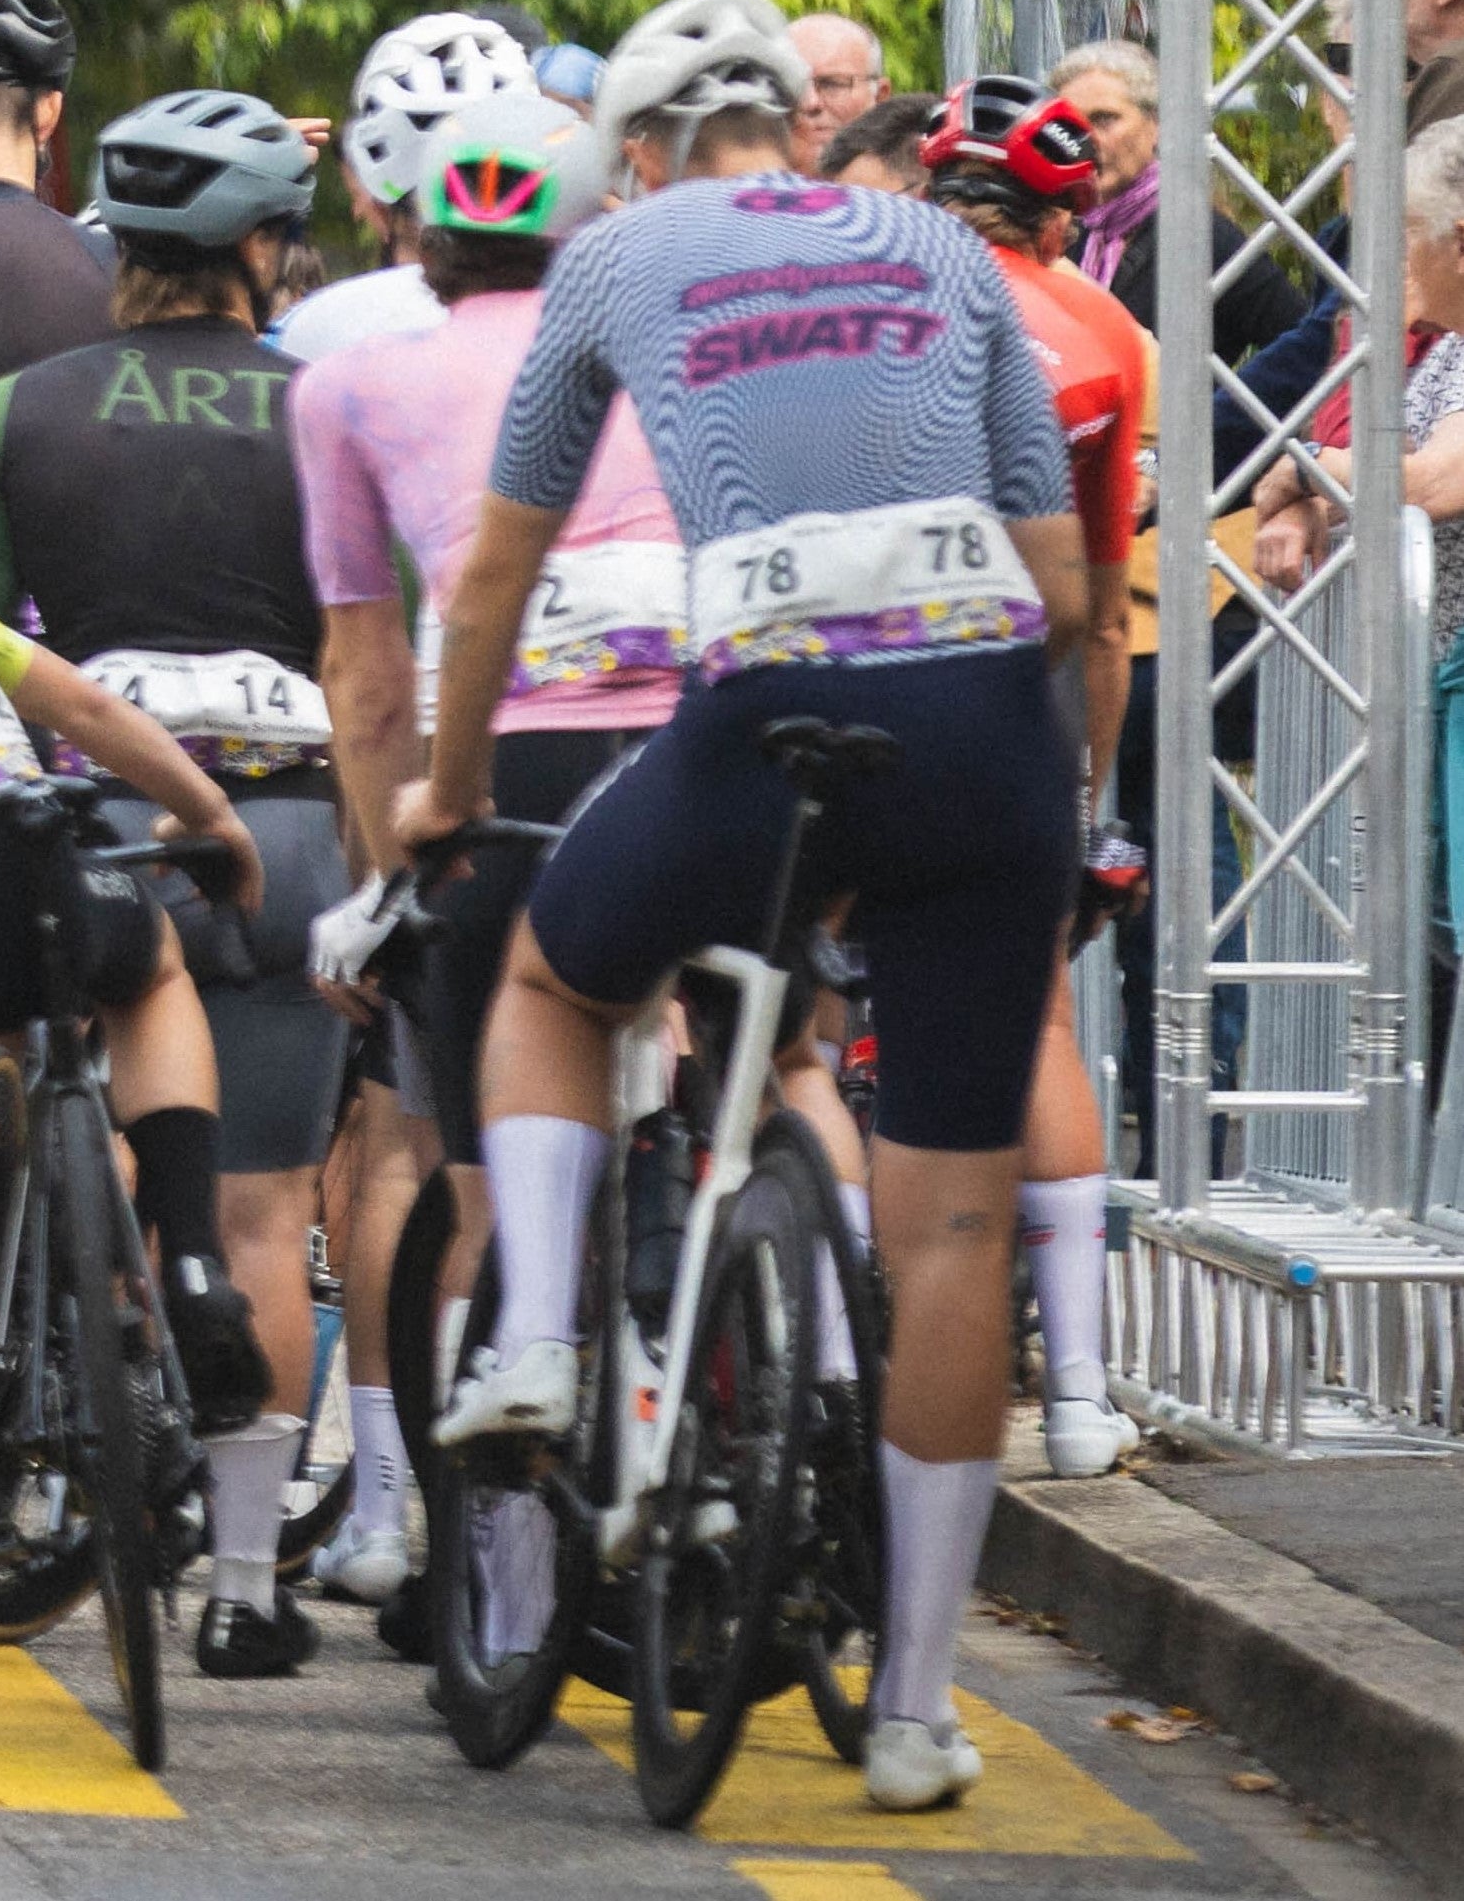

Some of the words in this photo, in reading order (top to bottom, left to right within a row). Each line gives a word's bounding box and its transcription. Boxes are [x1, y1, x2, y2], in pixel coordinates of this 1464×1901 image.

[689, 307, 938, 384] SWATT
[96, 349, 290, 430] ÅRT
[735, 547, 801, 600] 78
[920, 522, 990, 572] 78
[234, 675, 292, 716] 14
